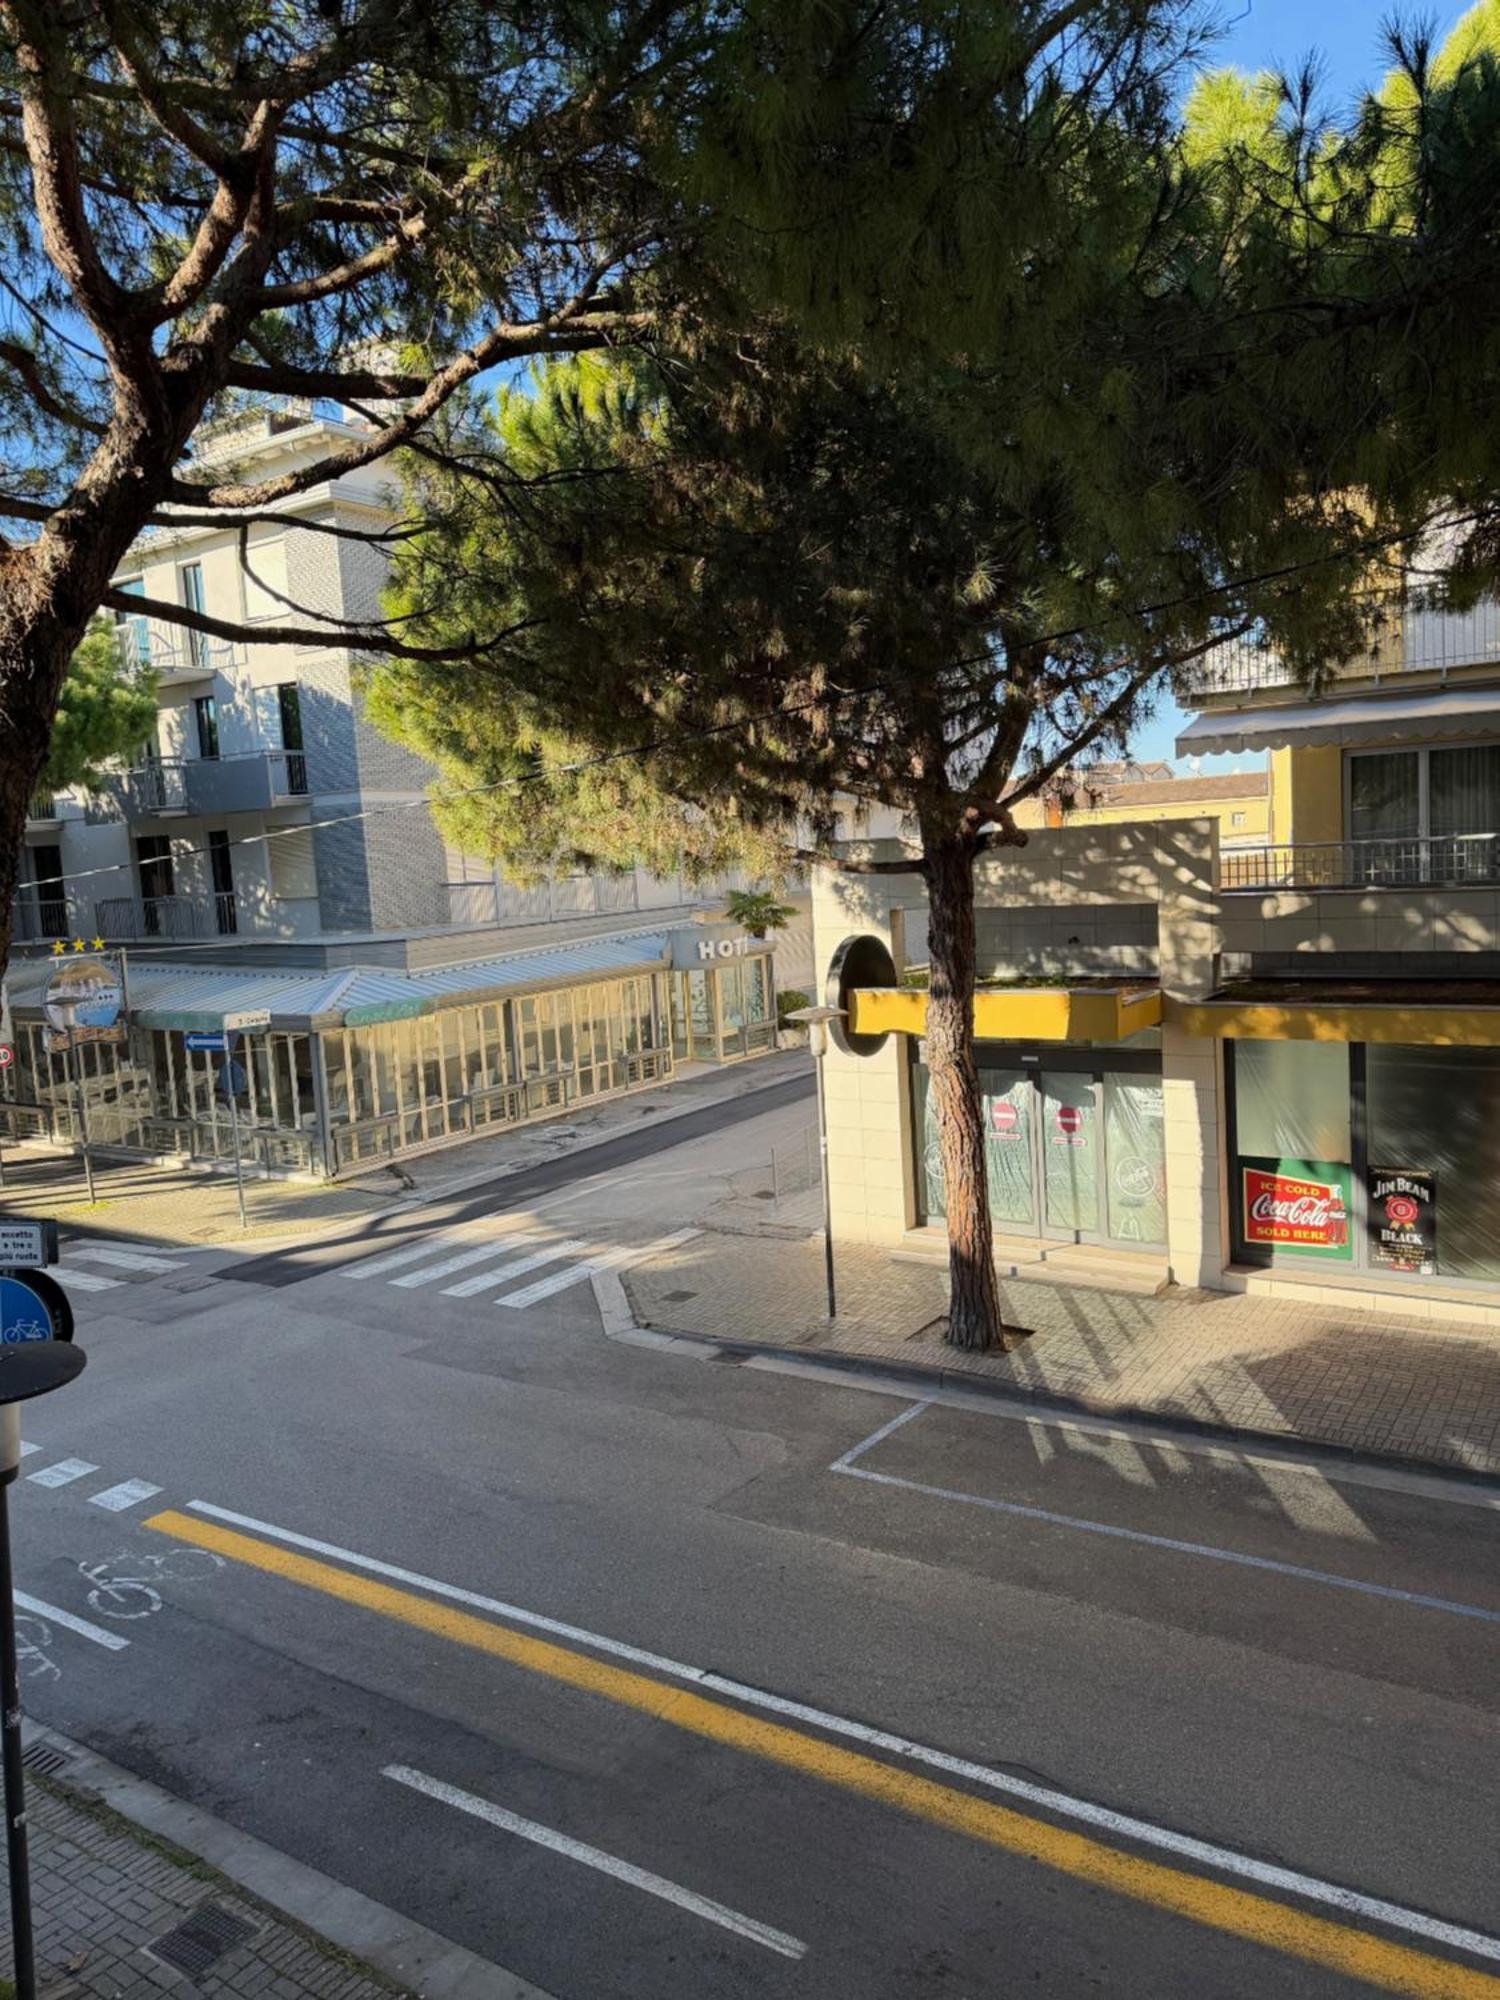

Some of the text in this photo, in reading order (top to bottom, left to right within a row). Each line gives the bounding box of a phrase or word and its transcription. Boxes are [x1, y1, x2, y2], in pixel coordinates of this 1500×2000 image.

[698, 936, 748, 960] HOT
[1260, 1181, 1321, 1197] ICE COLD
[1373, 1177, 1430, 1203] JIM BEAM
[1256, 1226, 1327, 1241] SOLD HERE
[1381, 1229, 1423, 1245] BLACK
